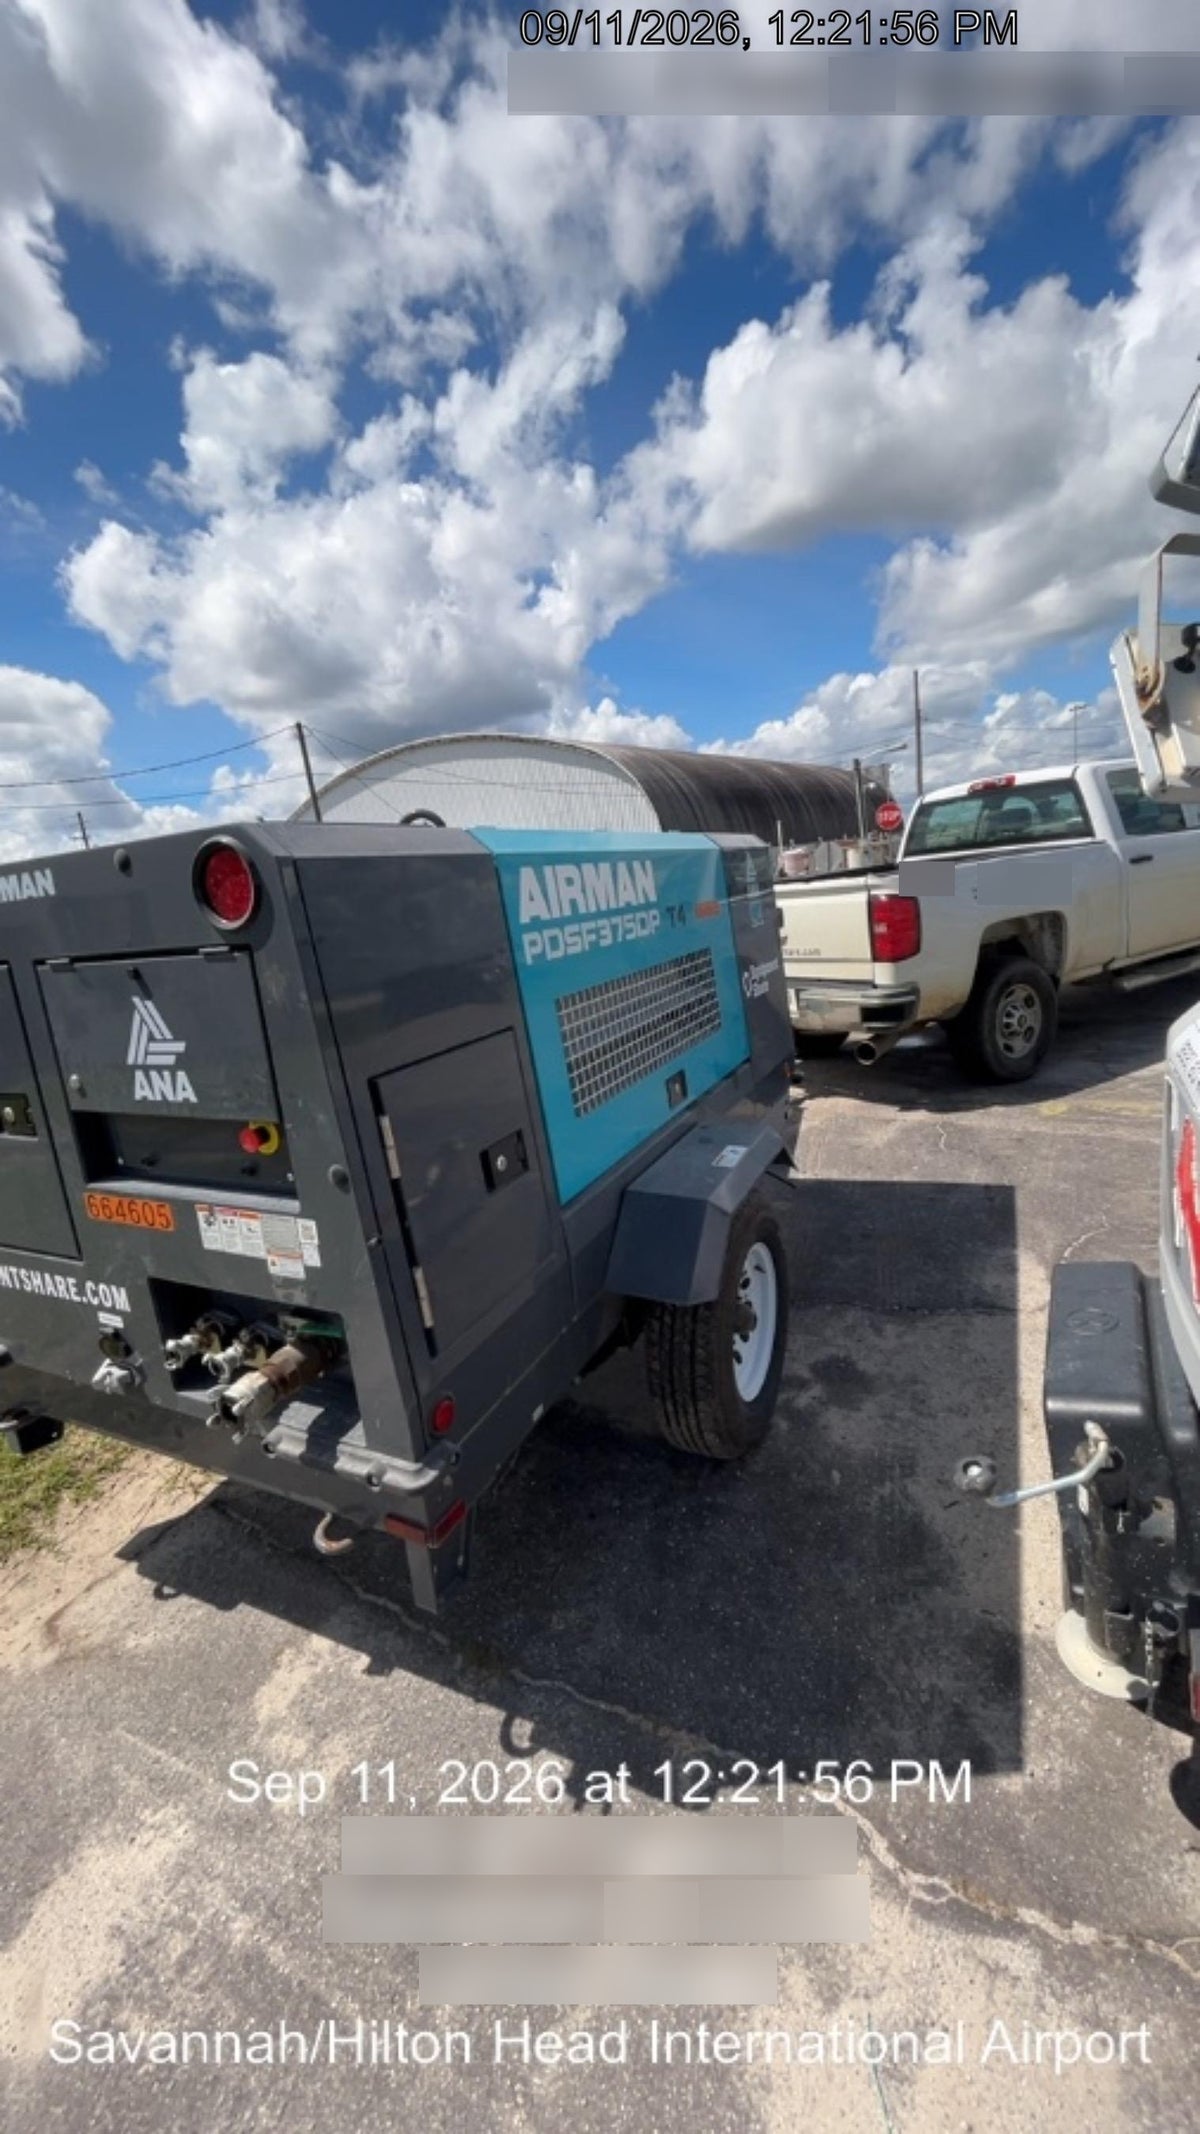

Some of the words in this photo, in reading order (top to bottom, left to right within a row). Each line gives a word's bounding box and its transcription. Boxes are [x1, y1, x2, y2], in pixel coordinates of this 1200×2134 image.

[0, 867, 56, 904] MAN
[518, 859, 658, 924] AIRMAN
[521, 910, 661, 966] PDSF375DP
[134, 1069, 199, 1103] ANA
[86, 1194, 174, 1229] 664605
